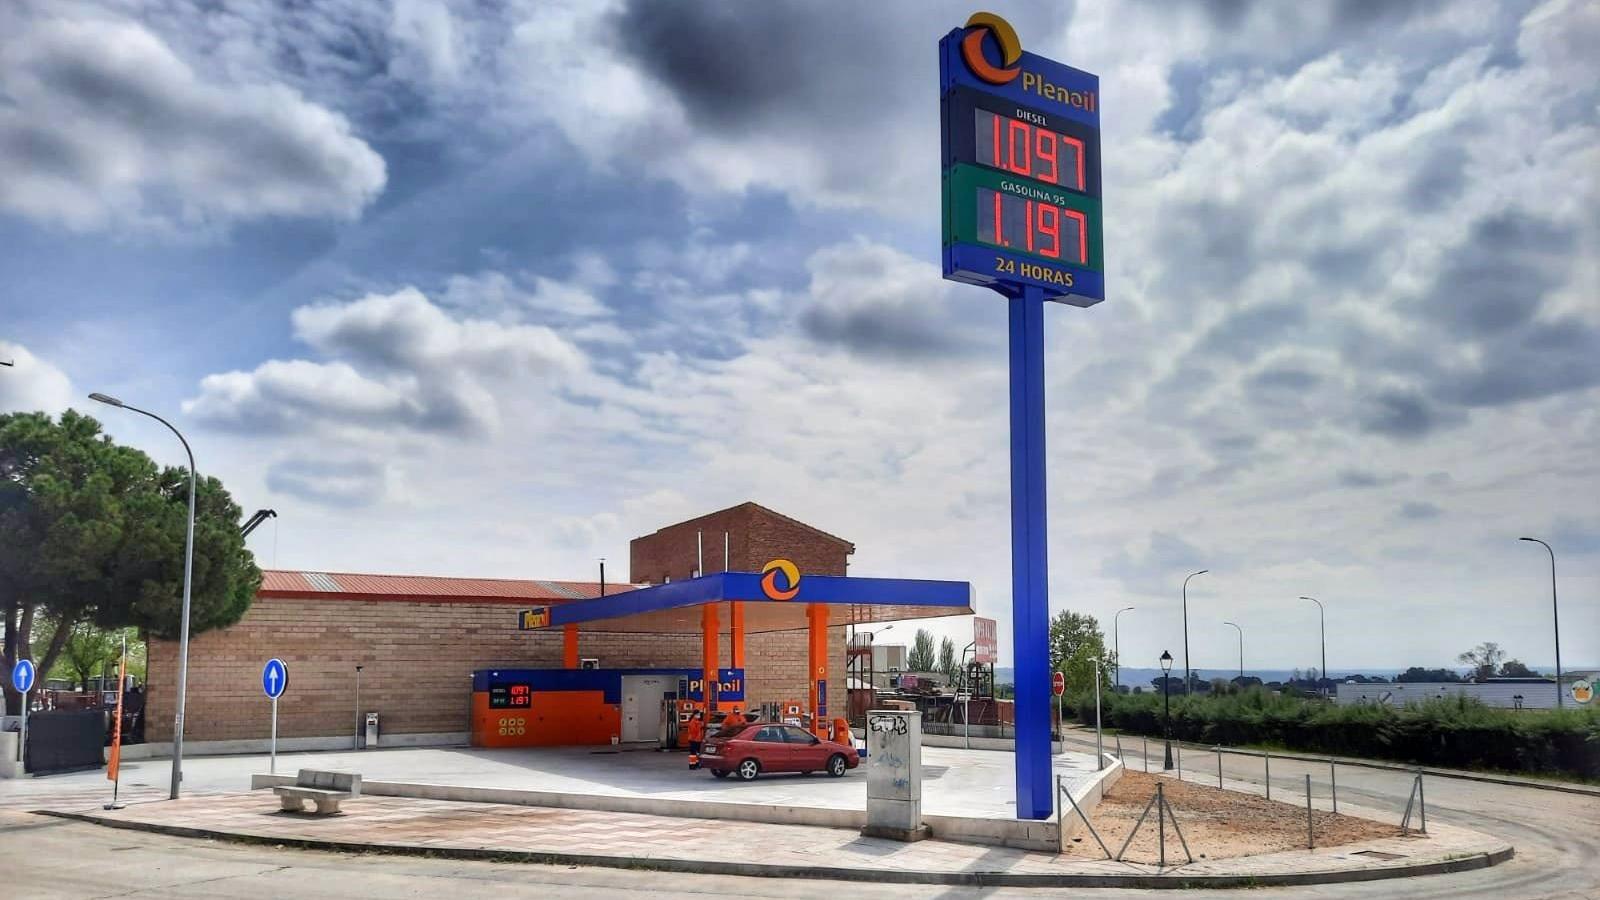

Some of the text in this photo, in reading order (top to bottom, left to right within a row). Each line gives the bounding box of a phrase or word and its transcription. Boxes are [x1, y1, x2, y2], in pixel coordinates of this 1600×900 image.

[1023, 71, 1095, 113] Plenoil
[1016, 108, 1048, 126] DIESEL
[993, 114, 1086, 192] 1.097
[1001, 181, 1065, 206] GASOLINA 95
[994, 191, 1087, 264] 1.197
[995, 257, 1073, 287] 24 HORAS
[689, 679, 740, 692] Ploil
